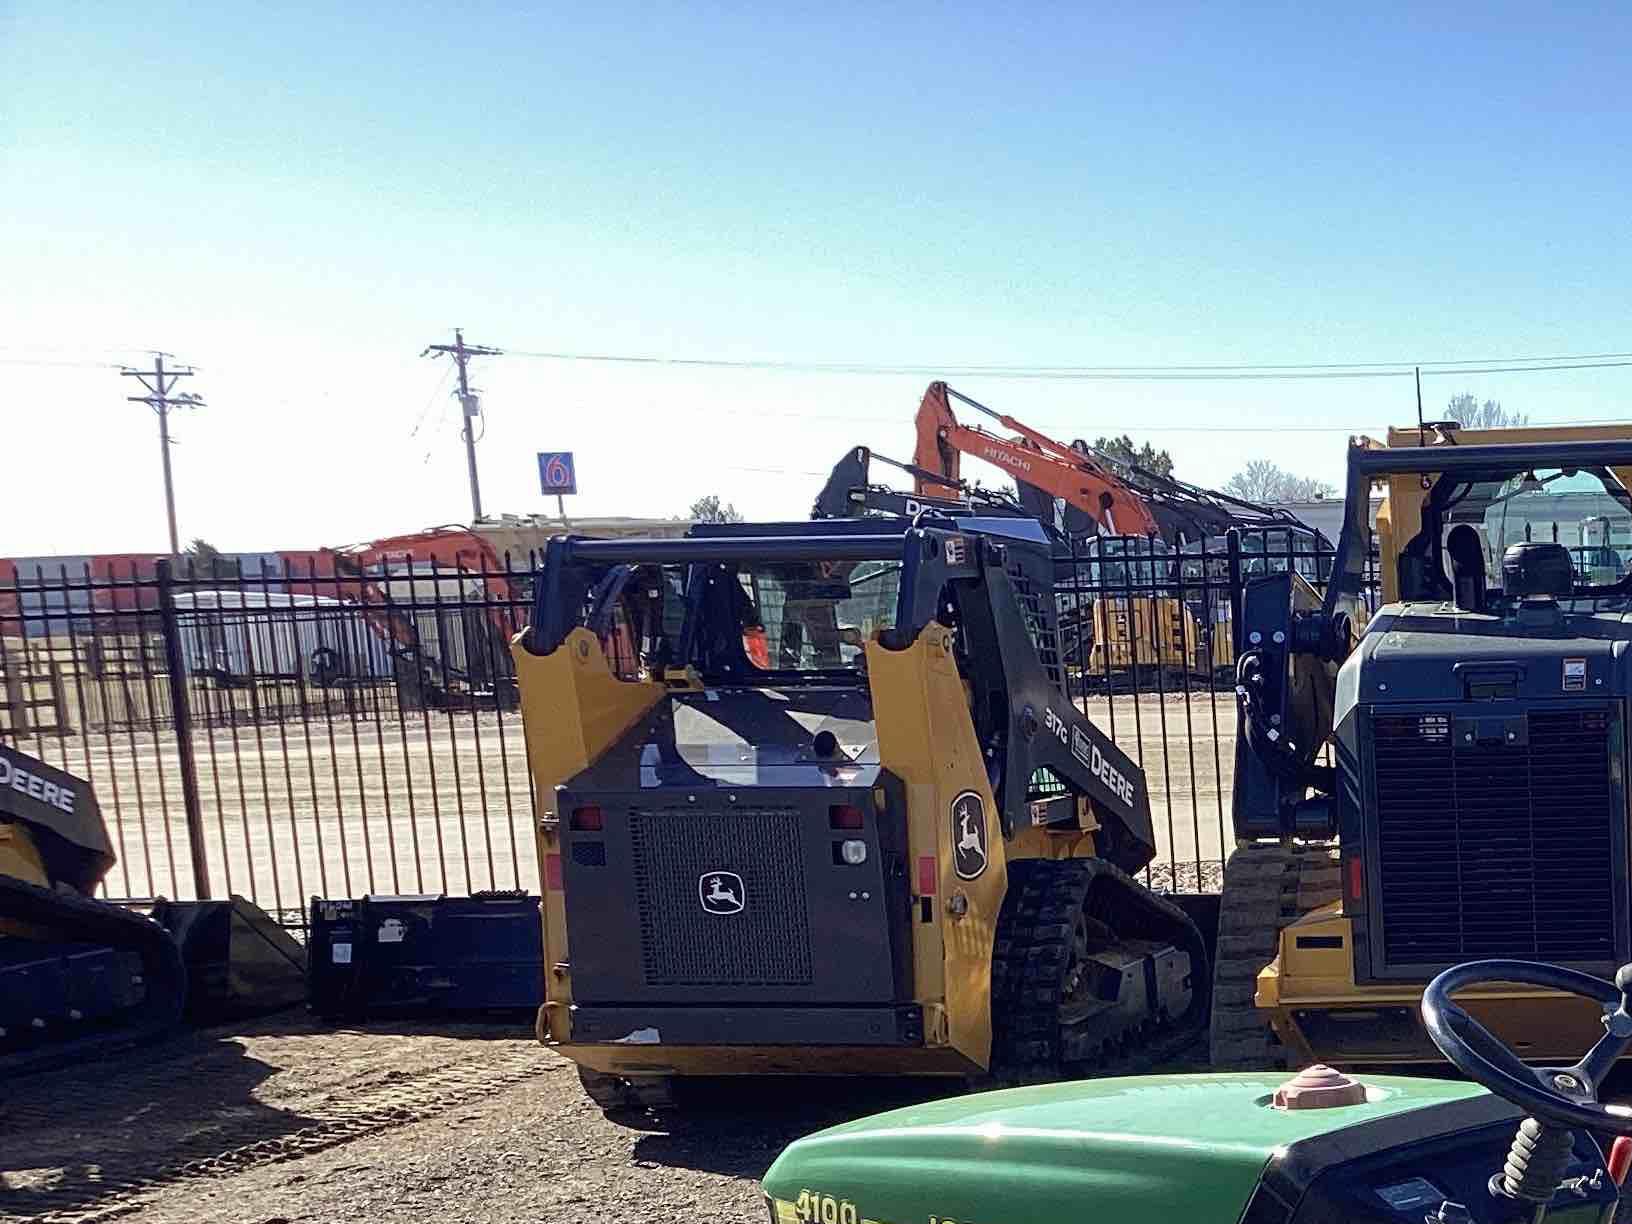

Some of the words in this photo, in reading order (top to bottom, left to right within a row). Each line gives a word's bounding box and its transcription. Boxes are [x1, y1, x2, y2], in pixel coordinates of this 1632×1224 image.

[546, 455, 570, 487] 6
[983, 446, 1032, 472] HITACHI
[1045, 707, 1068, 744] 317G
[1091, 744, 1135, 808] DEERE
